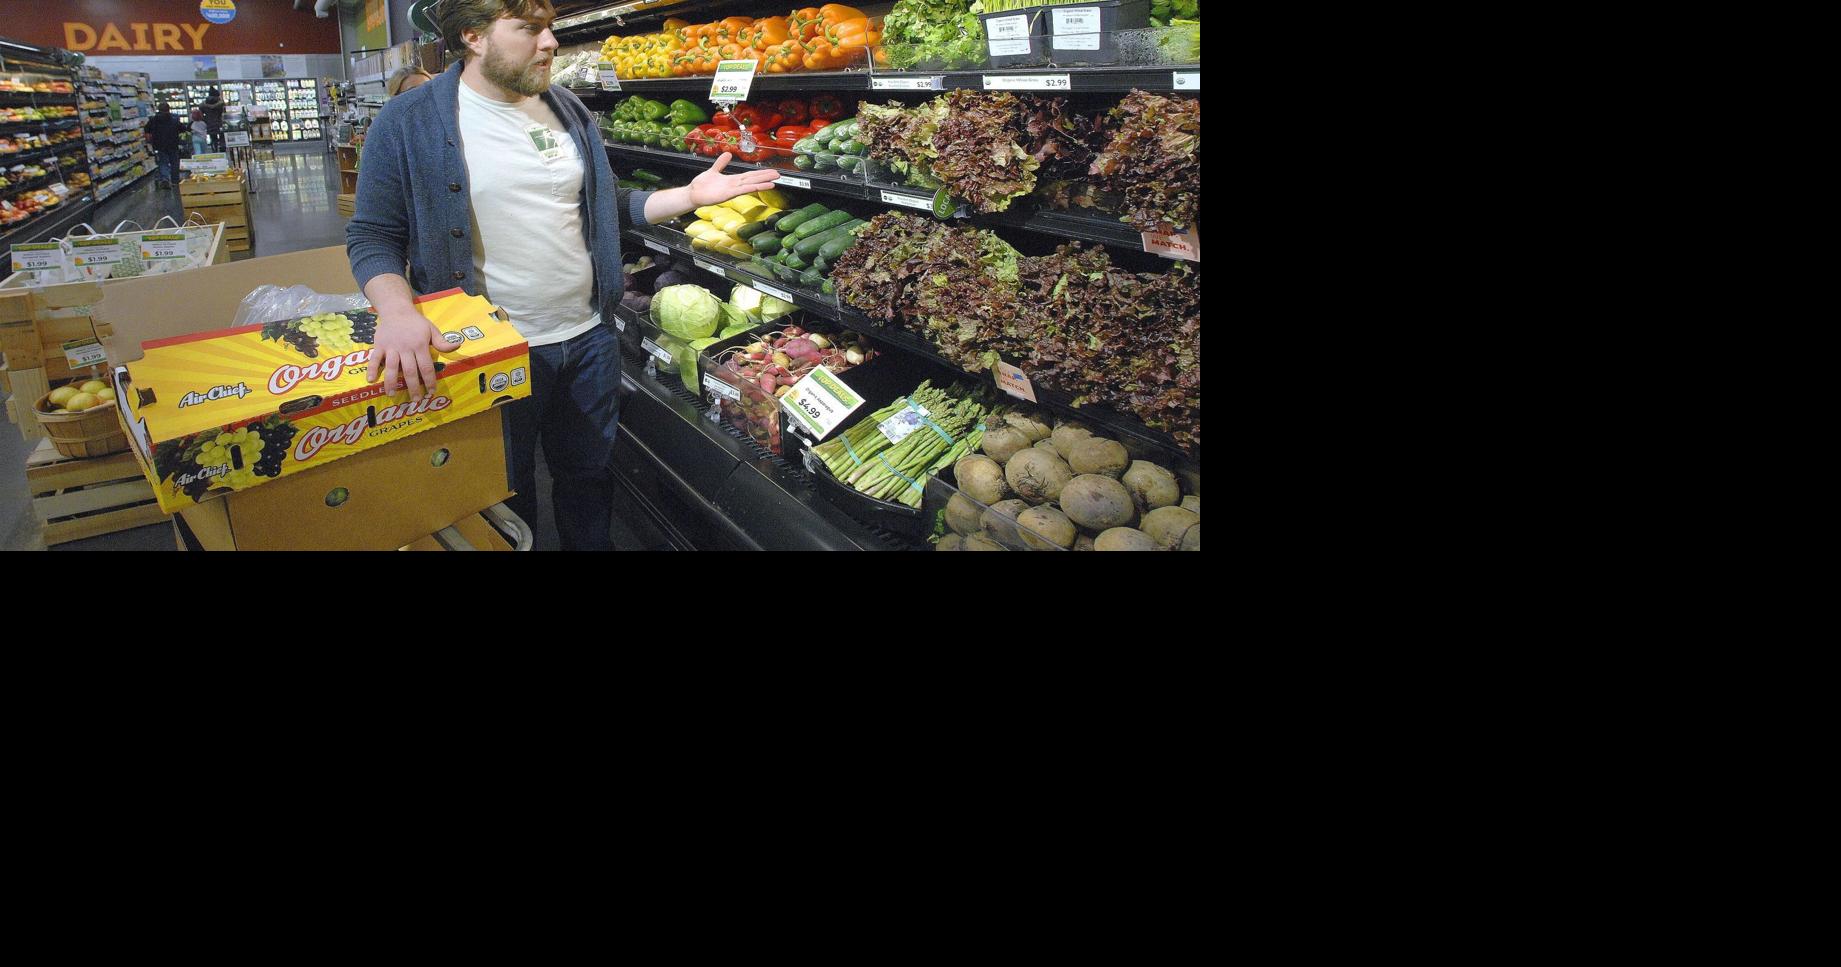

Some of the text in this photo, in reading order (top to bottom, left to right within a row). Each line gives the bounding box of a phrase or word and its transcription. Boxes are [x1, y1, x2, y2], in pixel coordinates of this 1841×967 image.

[63, 22, 210, 51] DAIRY
[720, 85, 738, 93] $2.99
[1045, 79, 1067, 87] $2.99
[938, 194, 951, 215] LOCA
[26, 260, 48, 268] $1.99
[87, 255, 108, 263] $1.99
[268, 349, 376, 394] Orga
[178, 382, 248, 409] Air Chief
[332, 381, 404, 407] SEEDLES
[798, 398, 821, 419] $4.99
[294, 394, 452, 461] Organic
[368, 416, 424, 438] GRAPES
[172, 463, 230, 489] Air Chief
